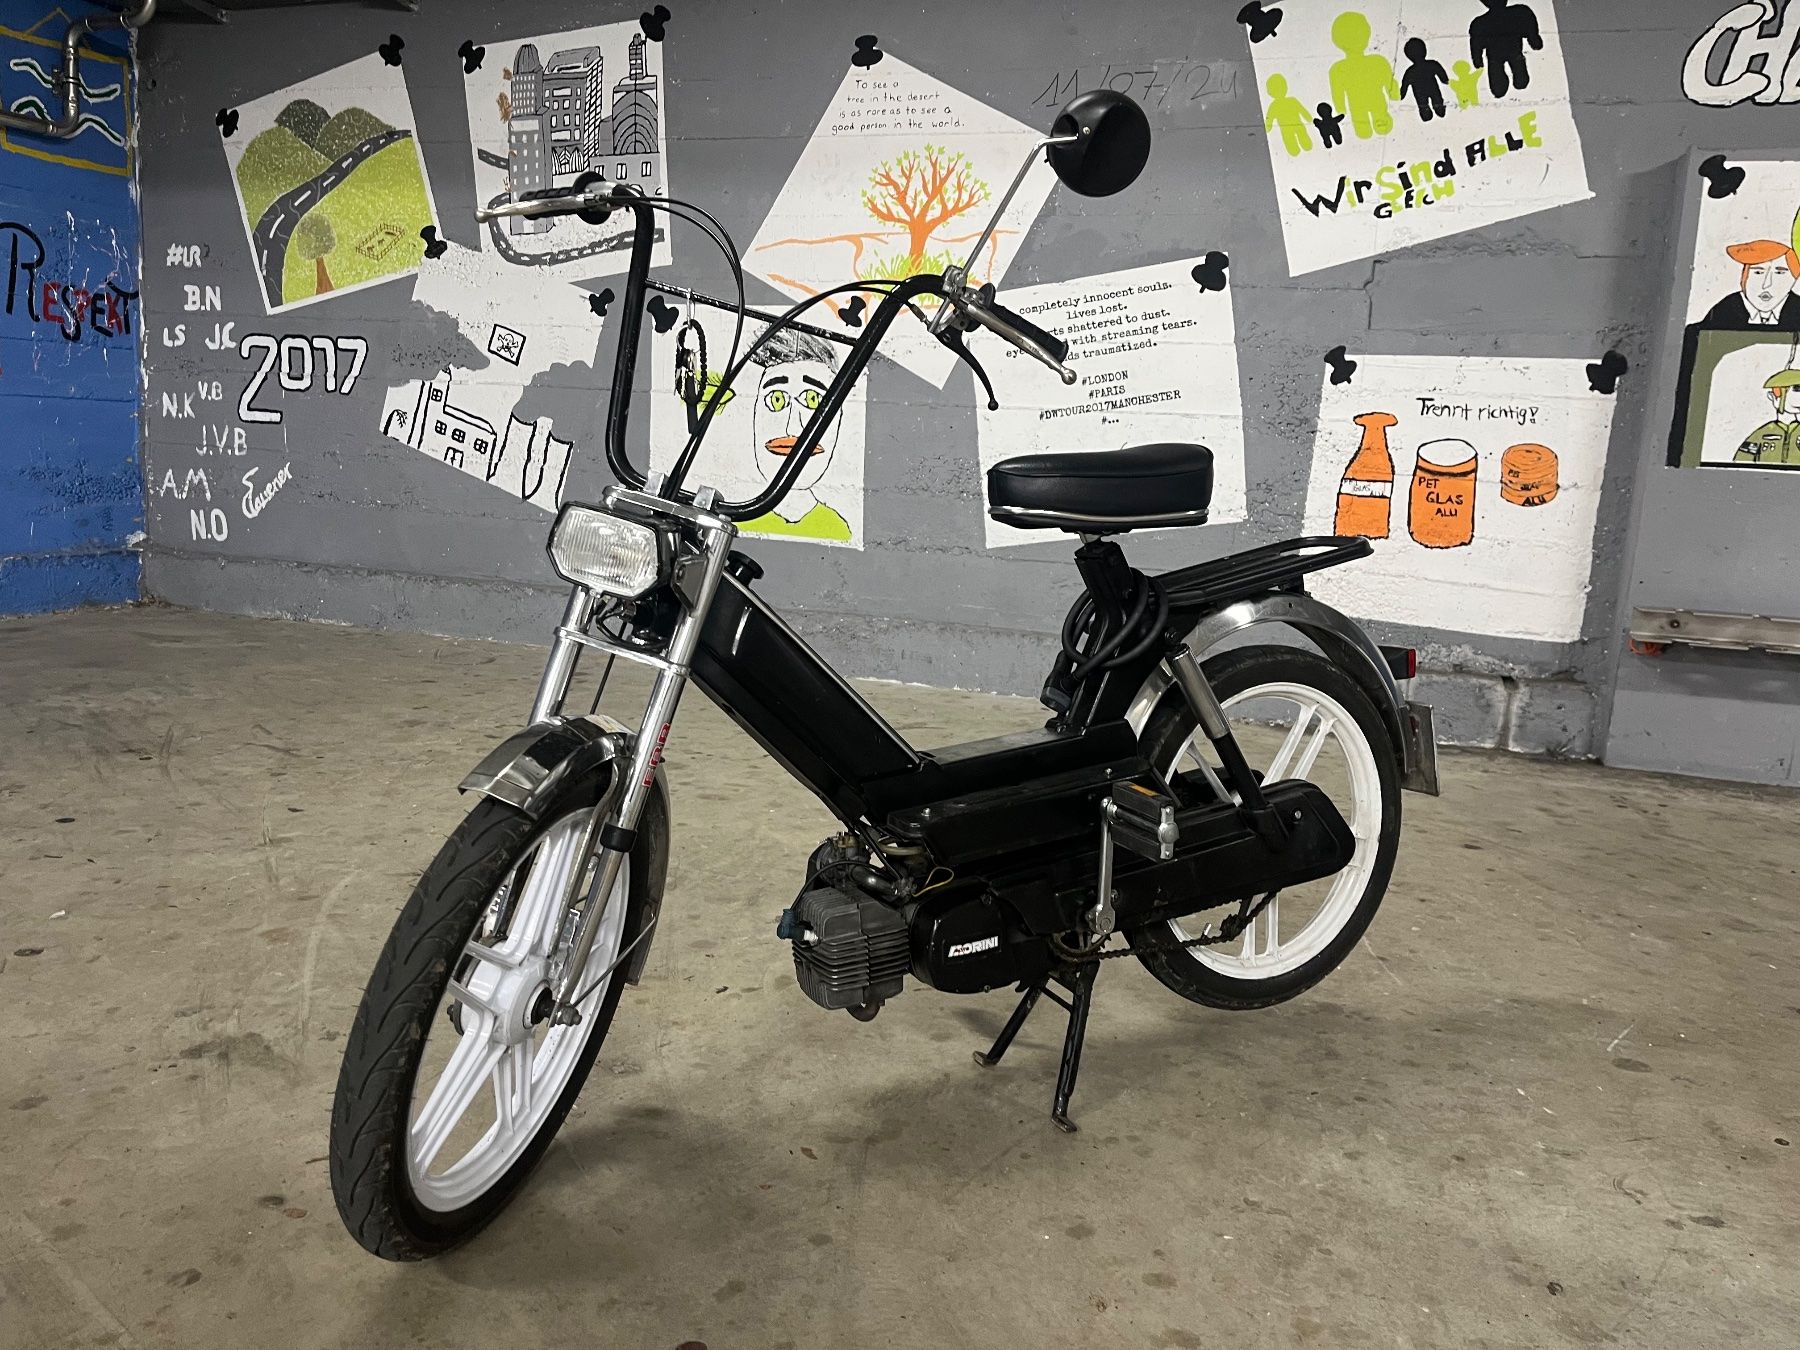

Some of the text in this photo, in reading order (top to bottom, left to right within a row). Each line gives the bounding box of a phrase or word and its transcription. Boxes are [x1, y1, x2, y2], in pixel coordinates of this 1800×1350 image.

[856, 79, 868, 89] To
[847, 95, 865, 103] tree
[883, 91, 902, 102] the
[907, 90, 940, 101] desert
[839, 110, 846, 119] is
[866, 108, 887, 116] rare
[906, 105, 917, 115] to
[943, 105, 952, 114] a
[831, 116, 965, 136] good person in the world.
[1291, 175, 1373, 218] Wir
[1465, 110, 1543, 168] ALLE
[183, 285, 222, 311] B.N
[1019, 281, 1172, 315] completely innocent souls.
[1066, 302, 1128, 320] lives lost.
[1067, 315, 1123, 334] shattered
[1125, 313, 1138, 324] to
[1141, 308, 1171, 321] dust.
[1071, 334, 1097, 345] with
[1101, 325, 1160, 341] streaming
[1161, 318, 1197, 331] tears.
[1082, 338, 1158, 359] traumatized.
[238, 333, 369, 424] 2017
[1081, 370, 1129, 386] #LONDON
[162, 380, 223, 419] N.K V.B
[1088, 385, 1126, 399] #PARIS
[1416, 397, 1539, 426] Trennt richtig!
[196, 423, 247, 456] J.V.B
[158, 467, 212, 501] A.M
[1418, 476, 1440, 489] PET
[1425, 491, 1464, 506] GLAS
[1435, 507, 1458, 518] ALU
[190, 508, 228, 542] N.O
